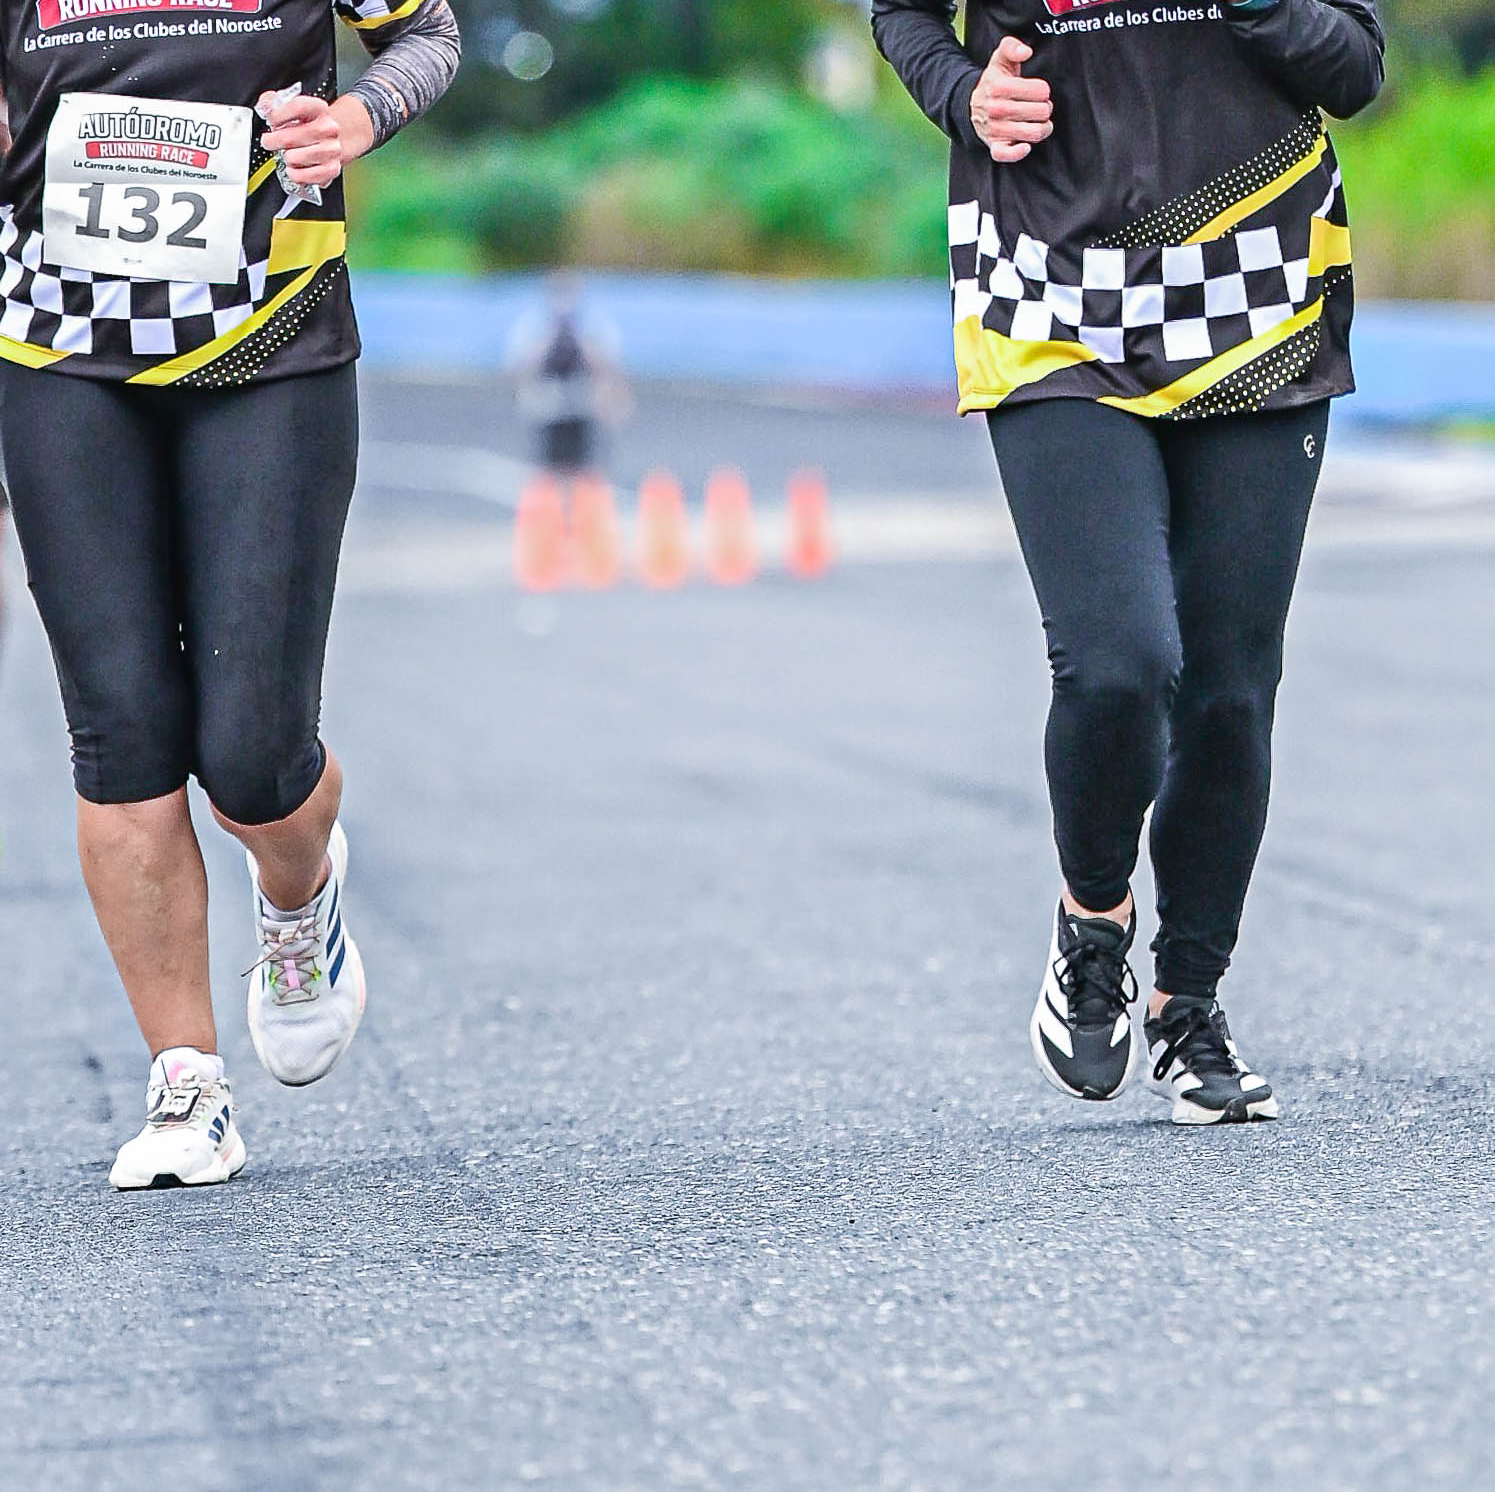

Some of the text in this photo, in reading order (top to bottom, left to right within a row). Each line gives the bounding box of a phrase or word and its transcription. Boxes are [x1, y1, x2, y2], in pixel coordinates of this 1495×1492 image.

[37, 32, 84, 50] Carrera
[86, 25, 107, 42] de
[108, 24, 132, 41] los
[133, 20, 186, 39] Clubes
[187, 17, 213, 35] del
[215, 15, 283, 34] Noroeste
[1053, 17, 1102, 36] Carrera
[1103, 11, 1124, 29] de
[1126, 8, 1150, 26] los
[1152, 6, 1204, 23] Clubes
[78, 107, 222, 150] AUTÓDROMO
[73, 160, 218, 180] La Carrera de los Clubes del Noroeste
[98, 142, 196, 166] RUNNING RACE
[75, 182, 208, 250] 132
